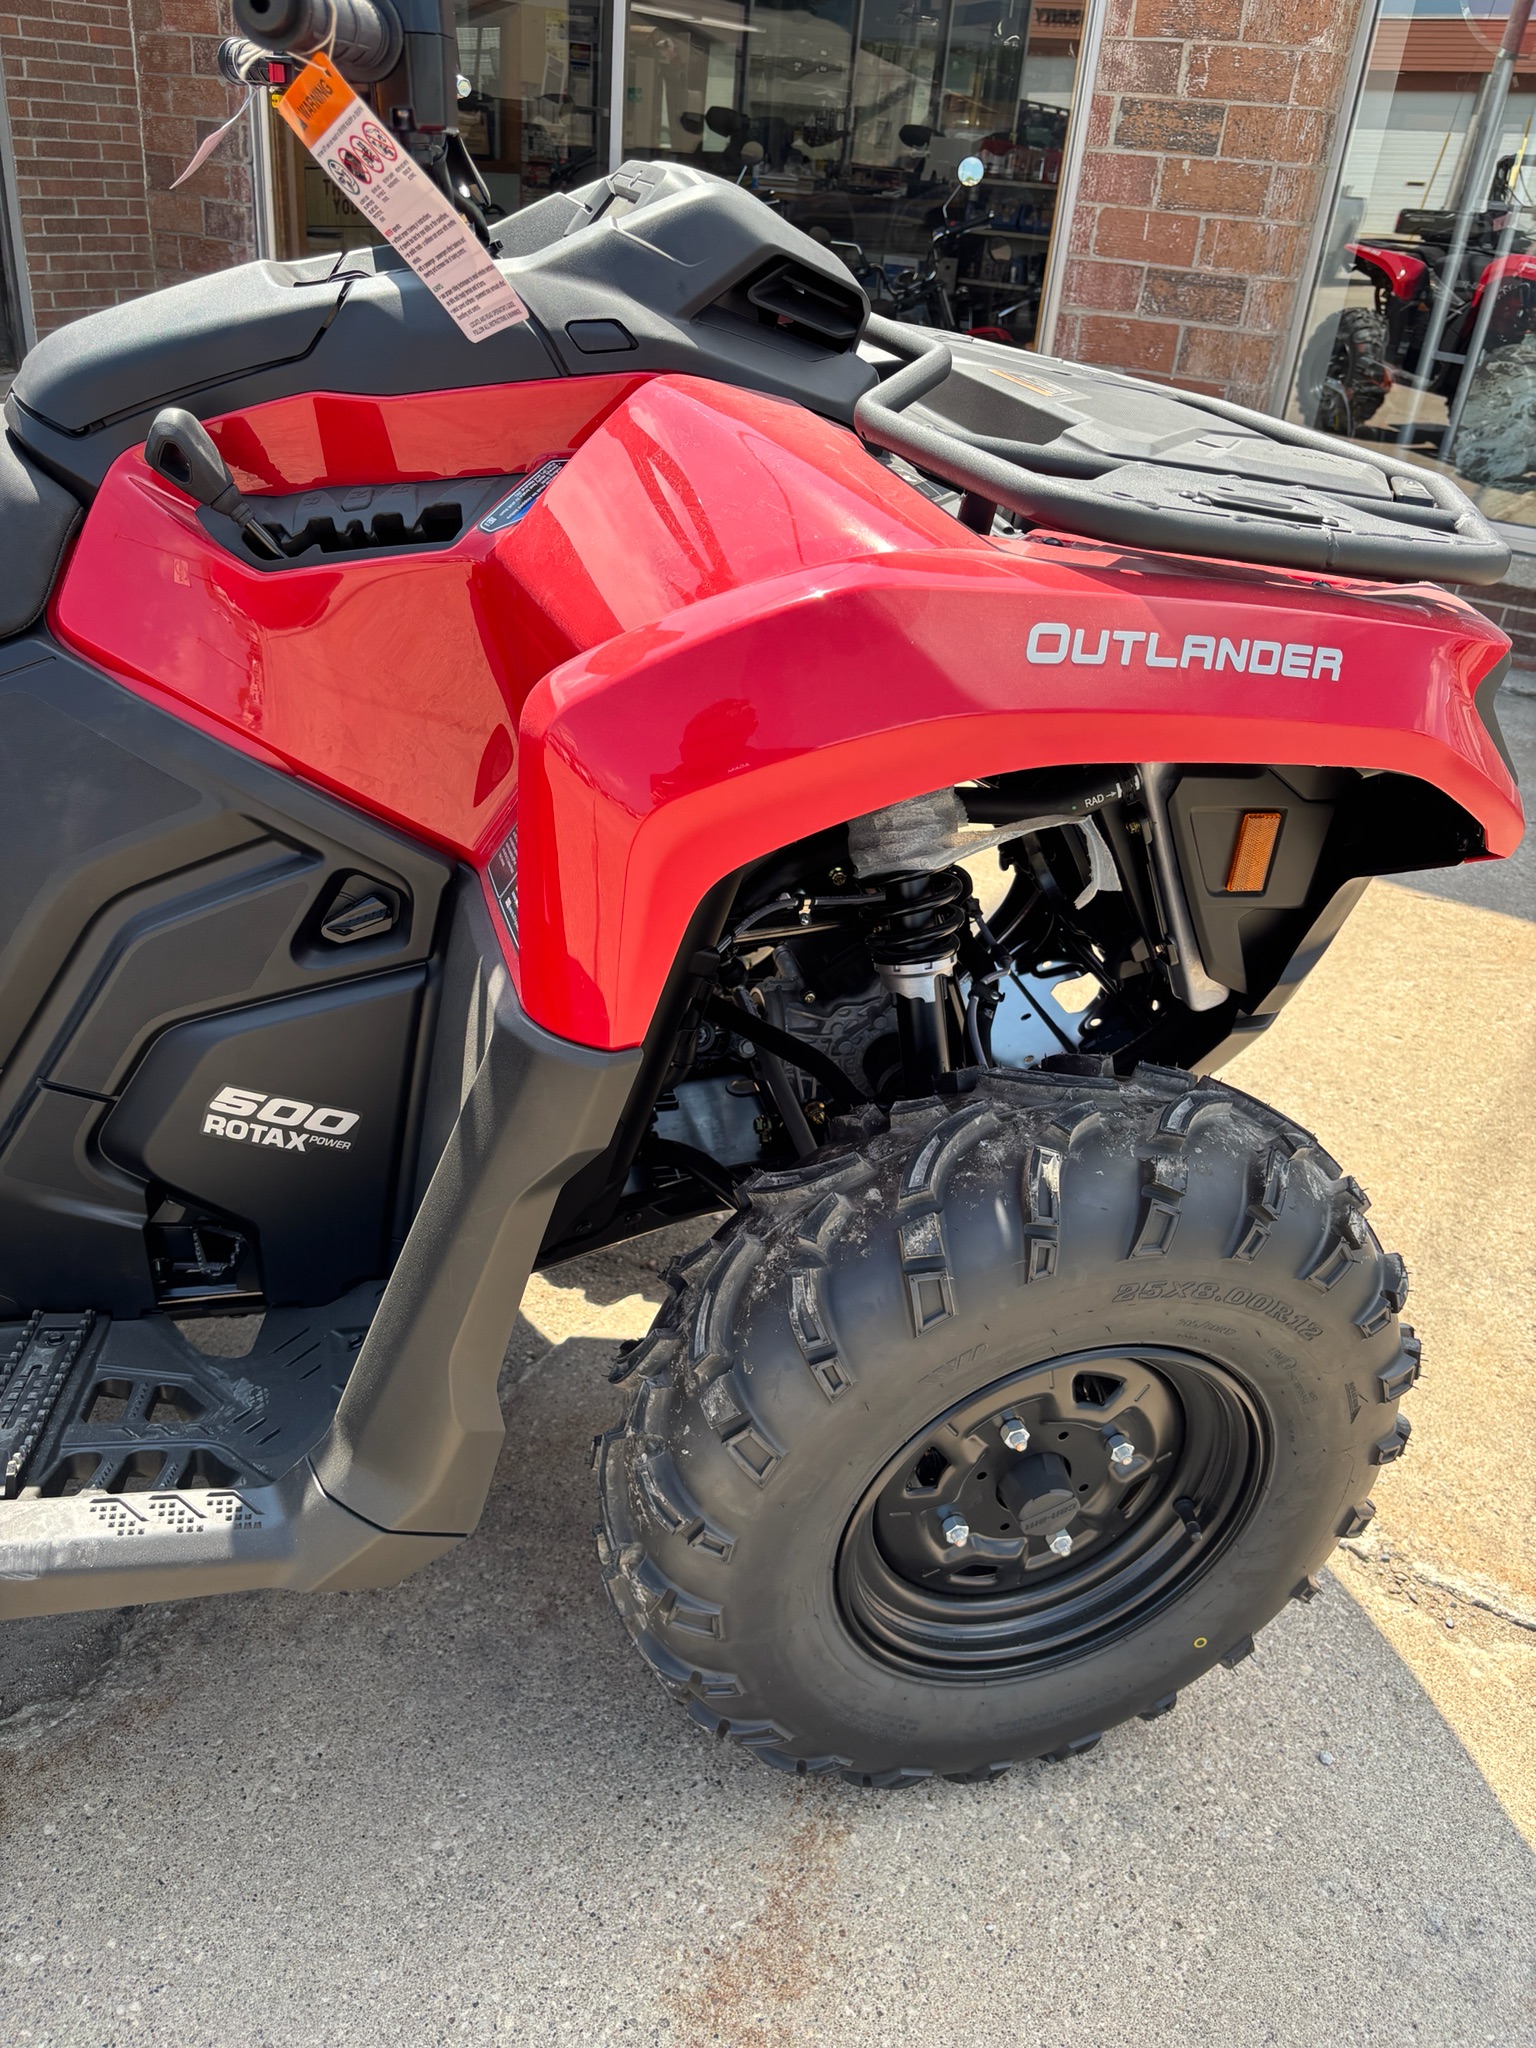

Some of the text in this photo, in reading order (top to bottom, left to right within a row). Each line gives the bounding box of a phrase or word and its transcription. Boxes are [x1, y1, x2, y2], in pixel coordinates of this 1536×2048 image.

[298, 79, 333, 120] WARNING
[1026, 622, 1344, 682] OUTLANDER
[1084, 793, 1105, 808] RAD
[203, 1113, 352, 1152] ROTAX POWER
[209, 1086, 360, 1136] 500
[1112, 1280, 1323, 1342] 25X8.00R12
